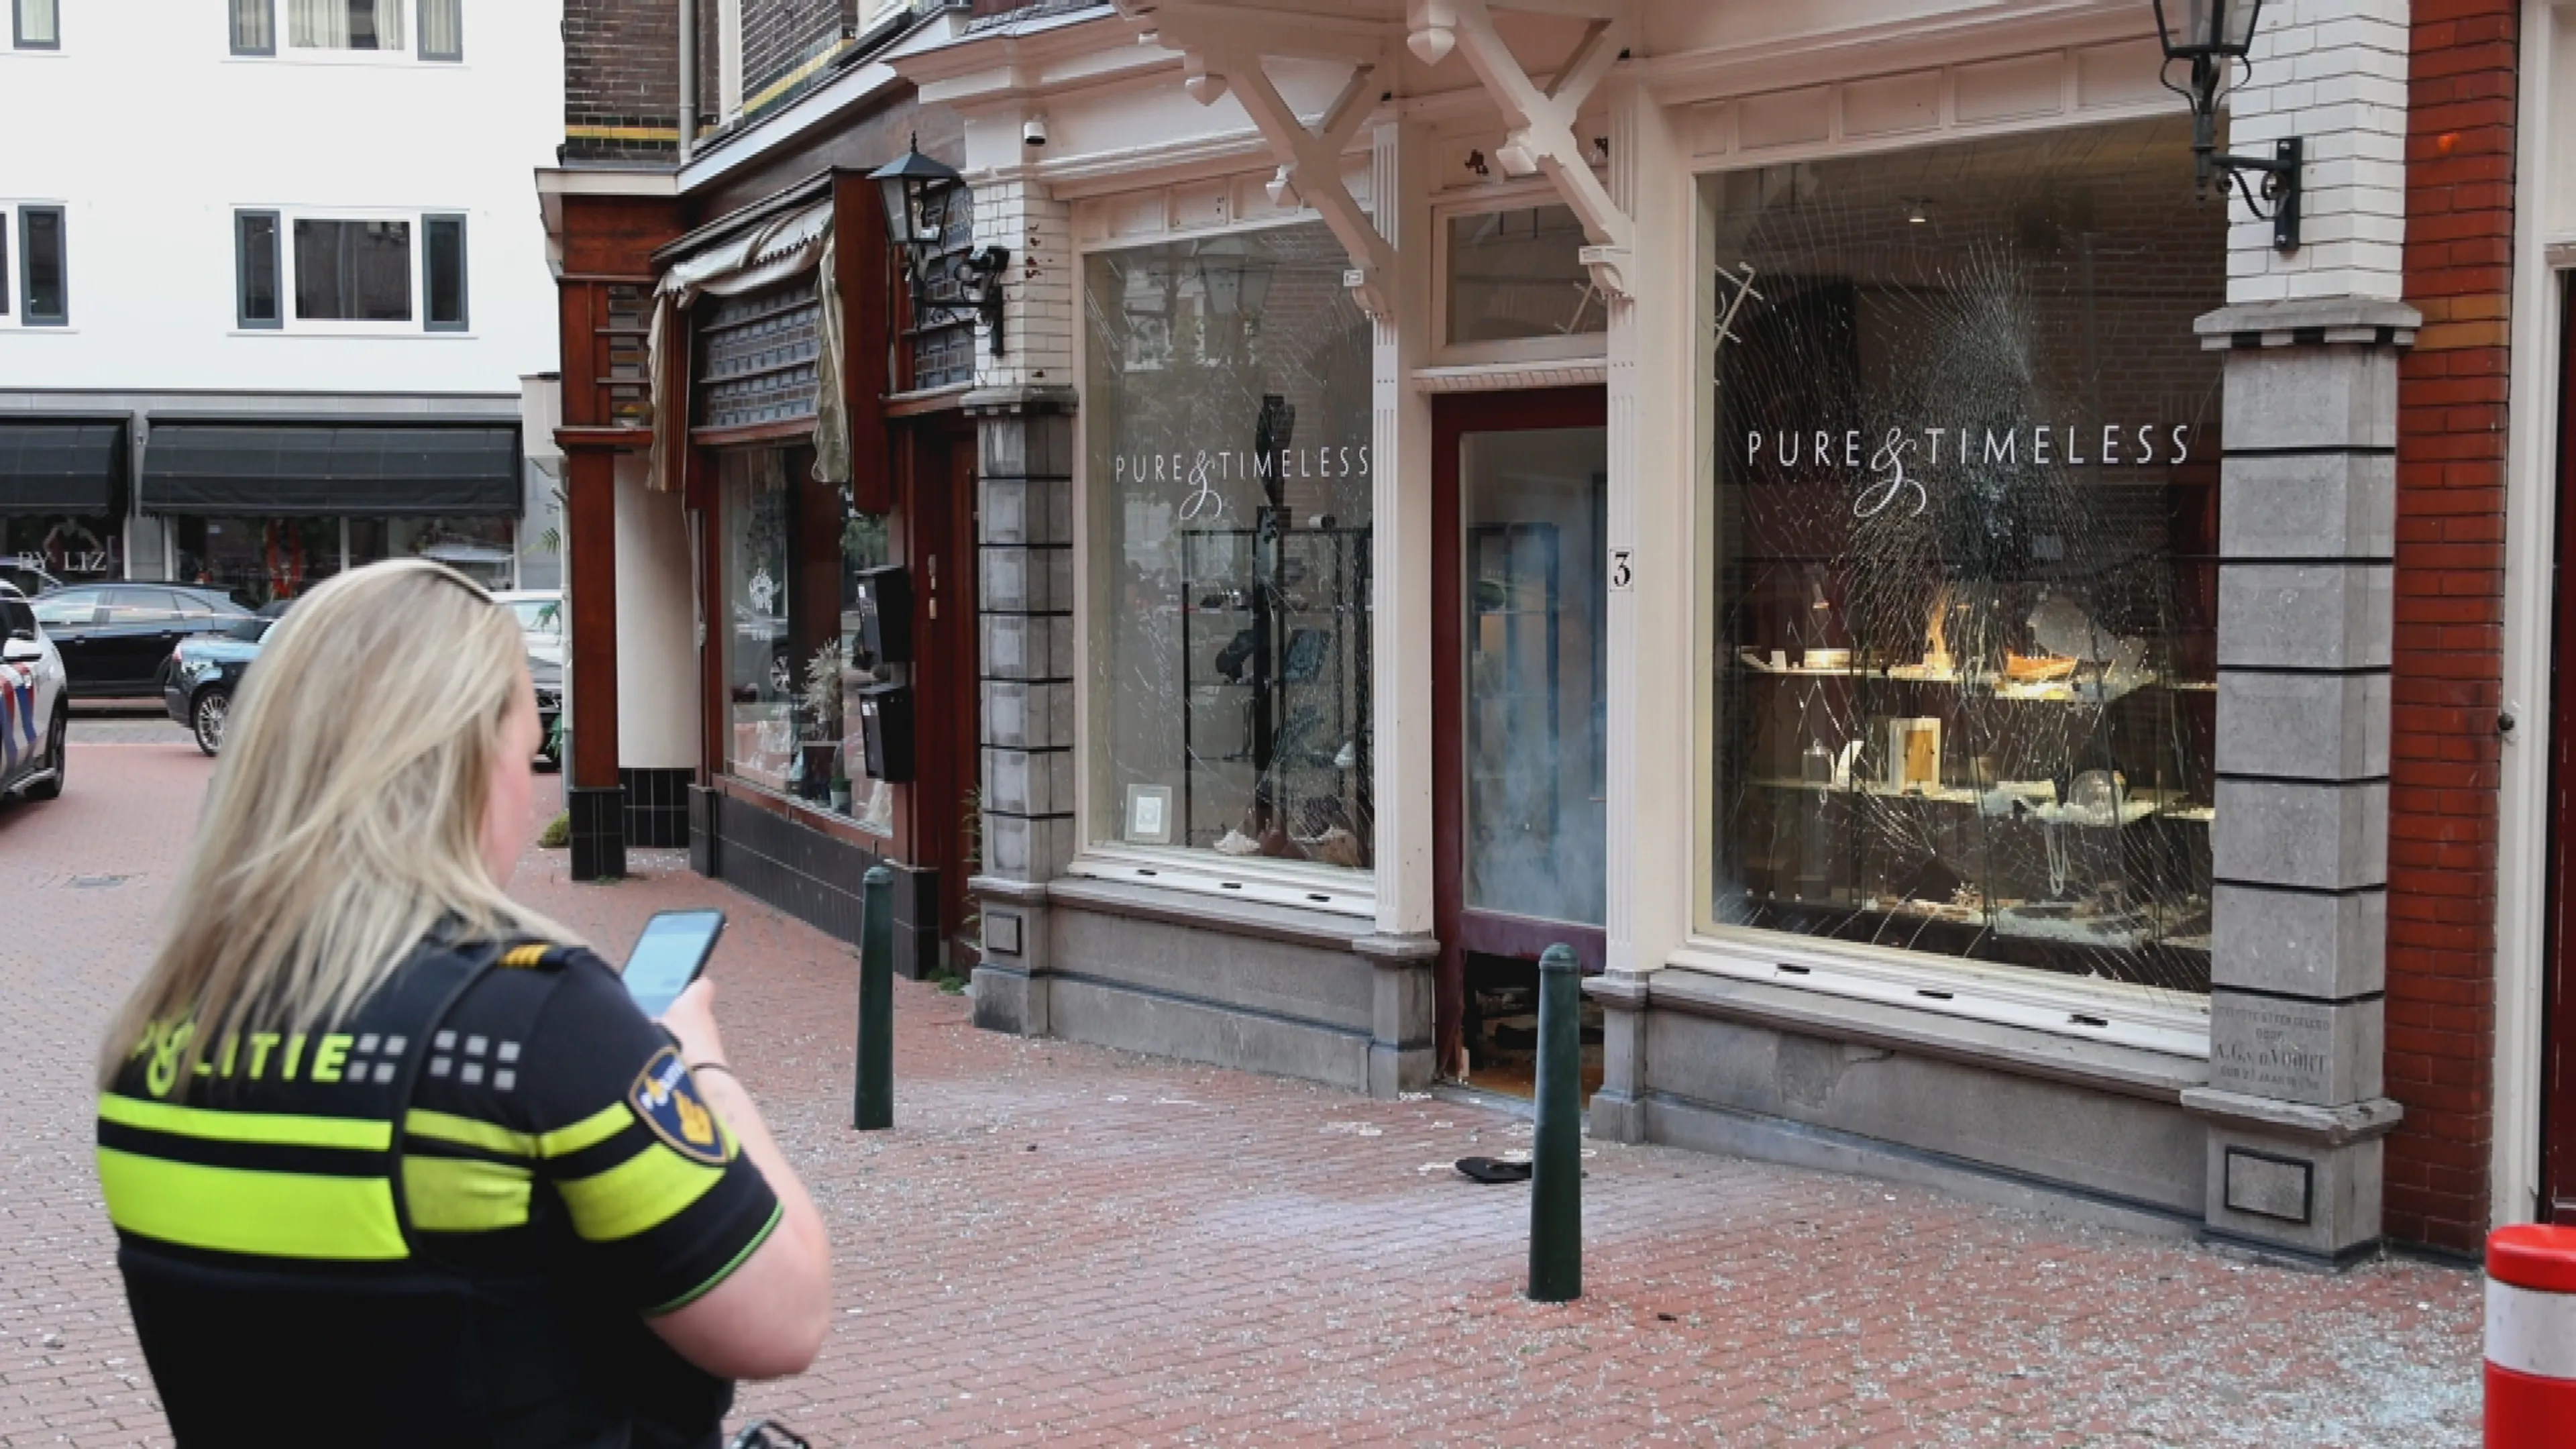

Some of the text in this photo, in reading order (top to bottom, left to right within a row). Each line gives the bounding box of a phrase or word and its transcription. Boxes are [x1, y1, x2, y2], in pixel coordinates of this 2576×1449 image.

[1748, 431, 1860, 466] PURE
[1925, 425, 2188, 464] TIMELESS
[1116, 453, 1182, 482] PURE
[1218, 447, 1368, 479] TIMELESS
[64, 551, 107, 571] LIZ
[1613, 551, 1631, 587] 3
